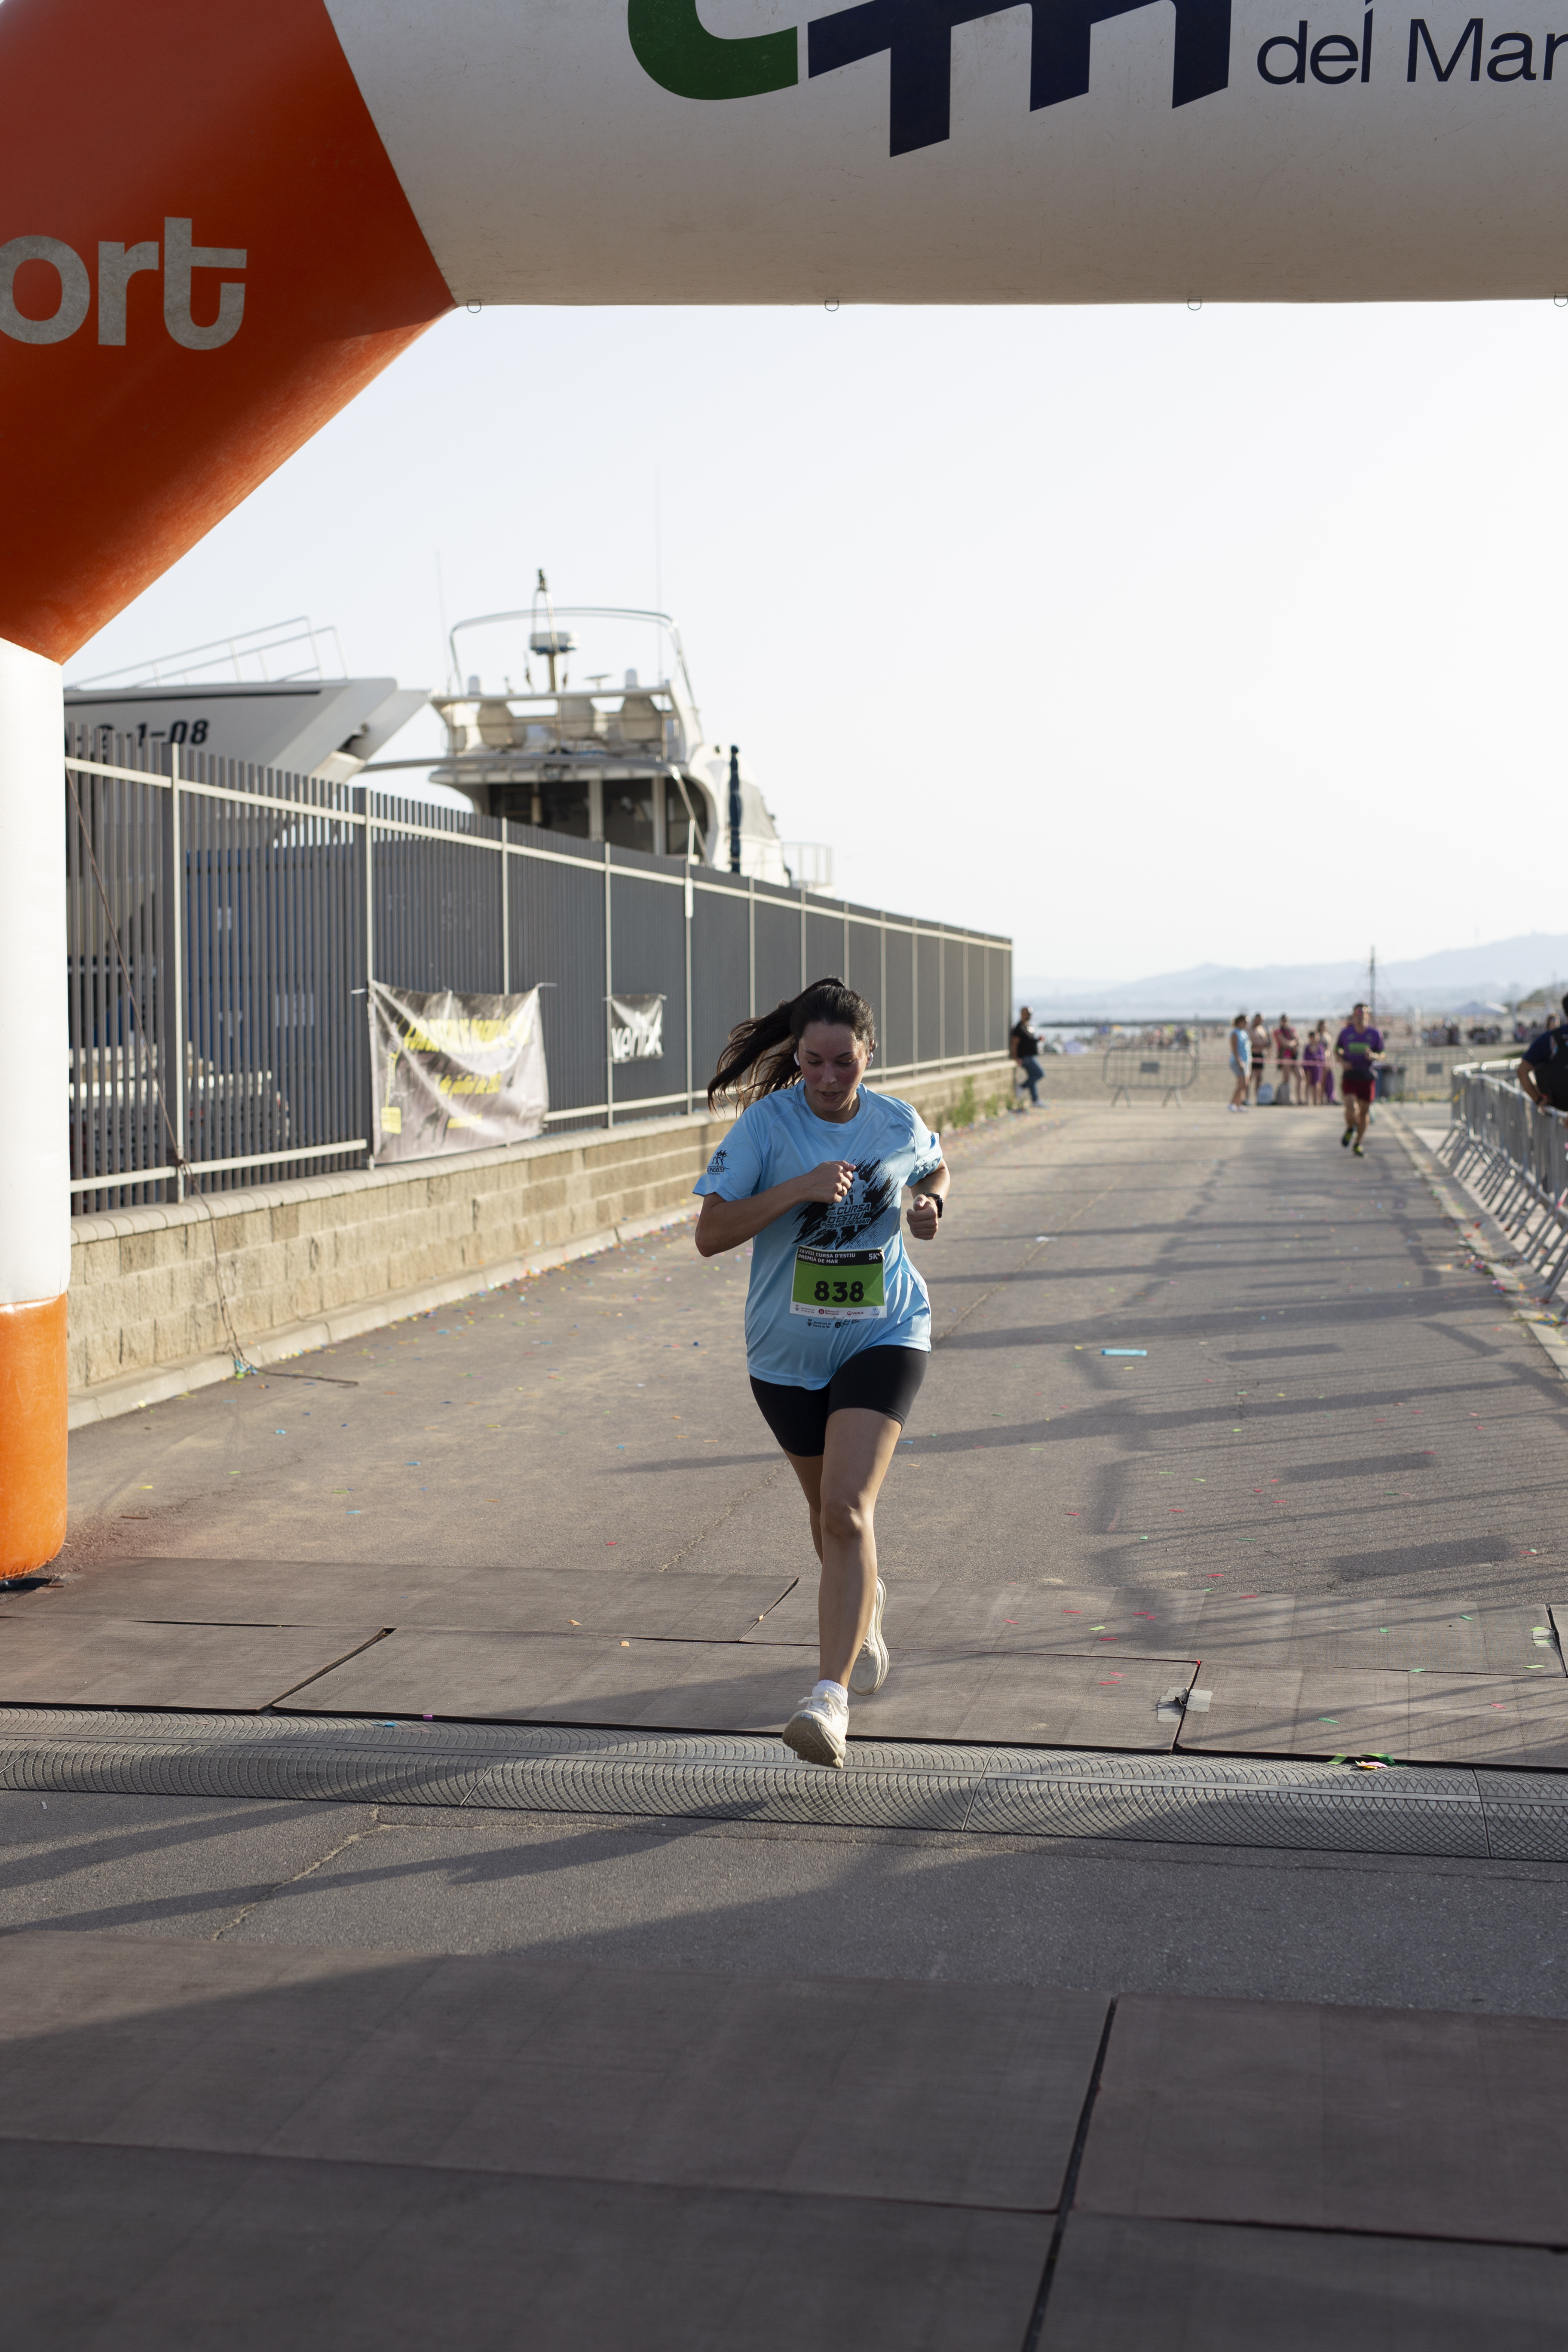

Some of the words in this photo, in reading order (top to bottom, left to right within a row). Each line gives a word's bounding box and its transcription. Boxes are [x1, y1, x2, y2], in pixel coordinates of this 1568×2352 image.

[1256, 7, 1373, 85] del
[836, 1204, 870, 1215] CURSA
[827, 1212, 864, 1224] D'ESTIU
[798, 1254, 817, 1262] PREMIÀ
[814, 1280, 864, 1303] 838
